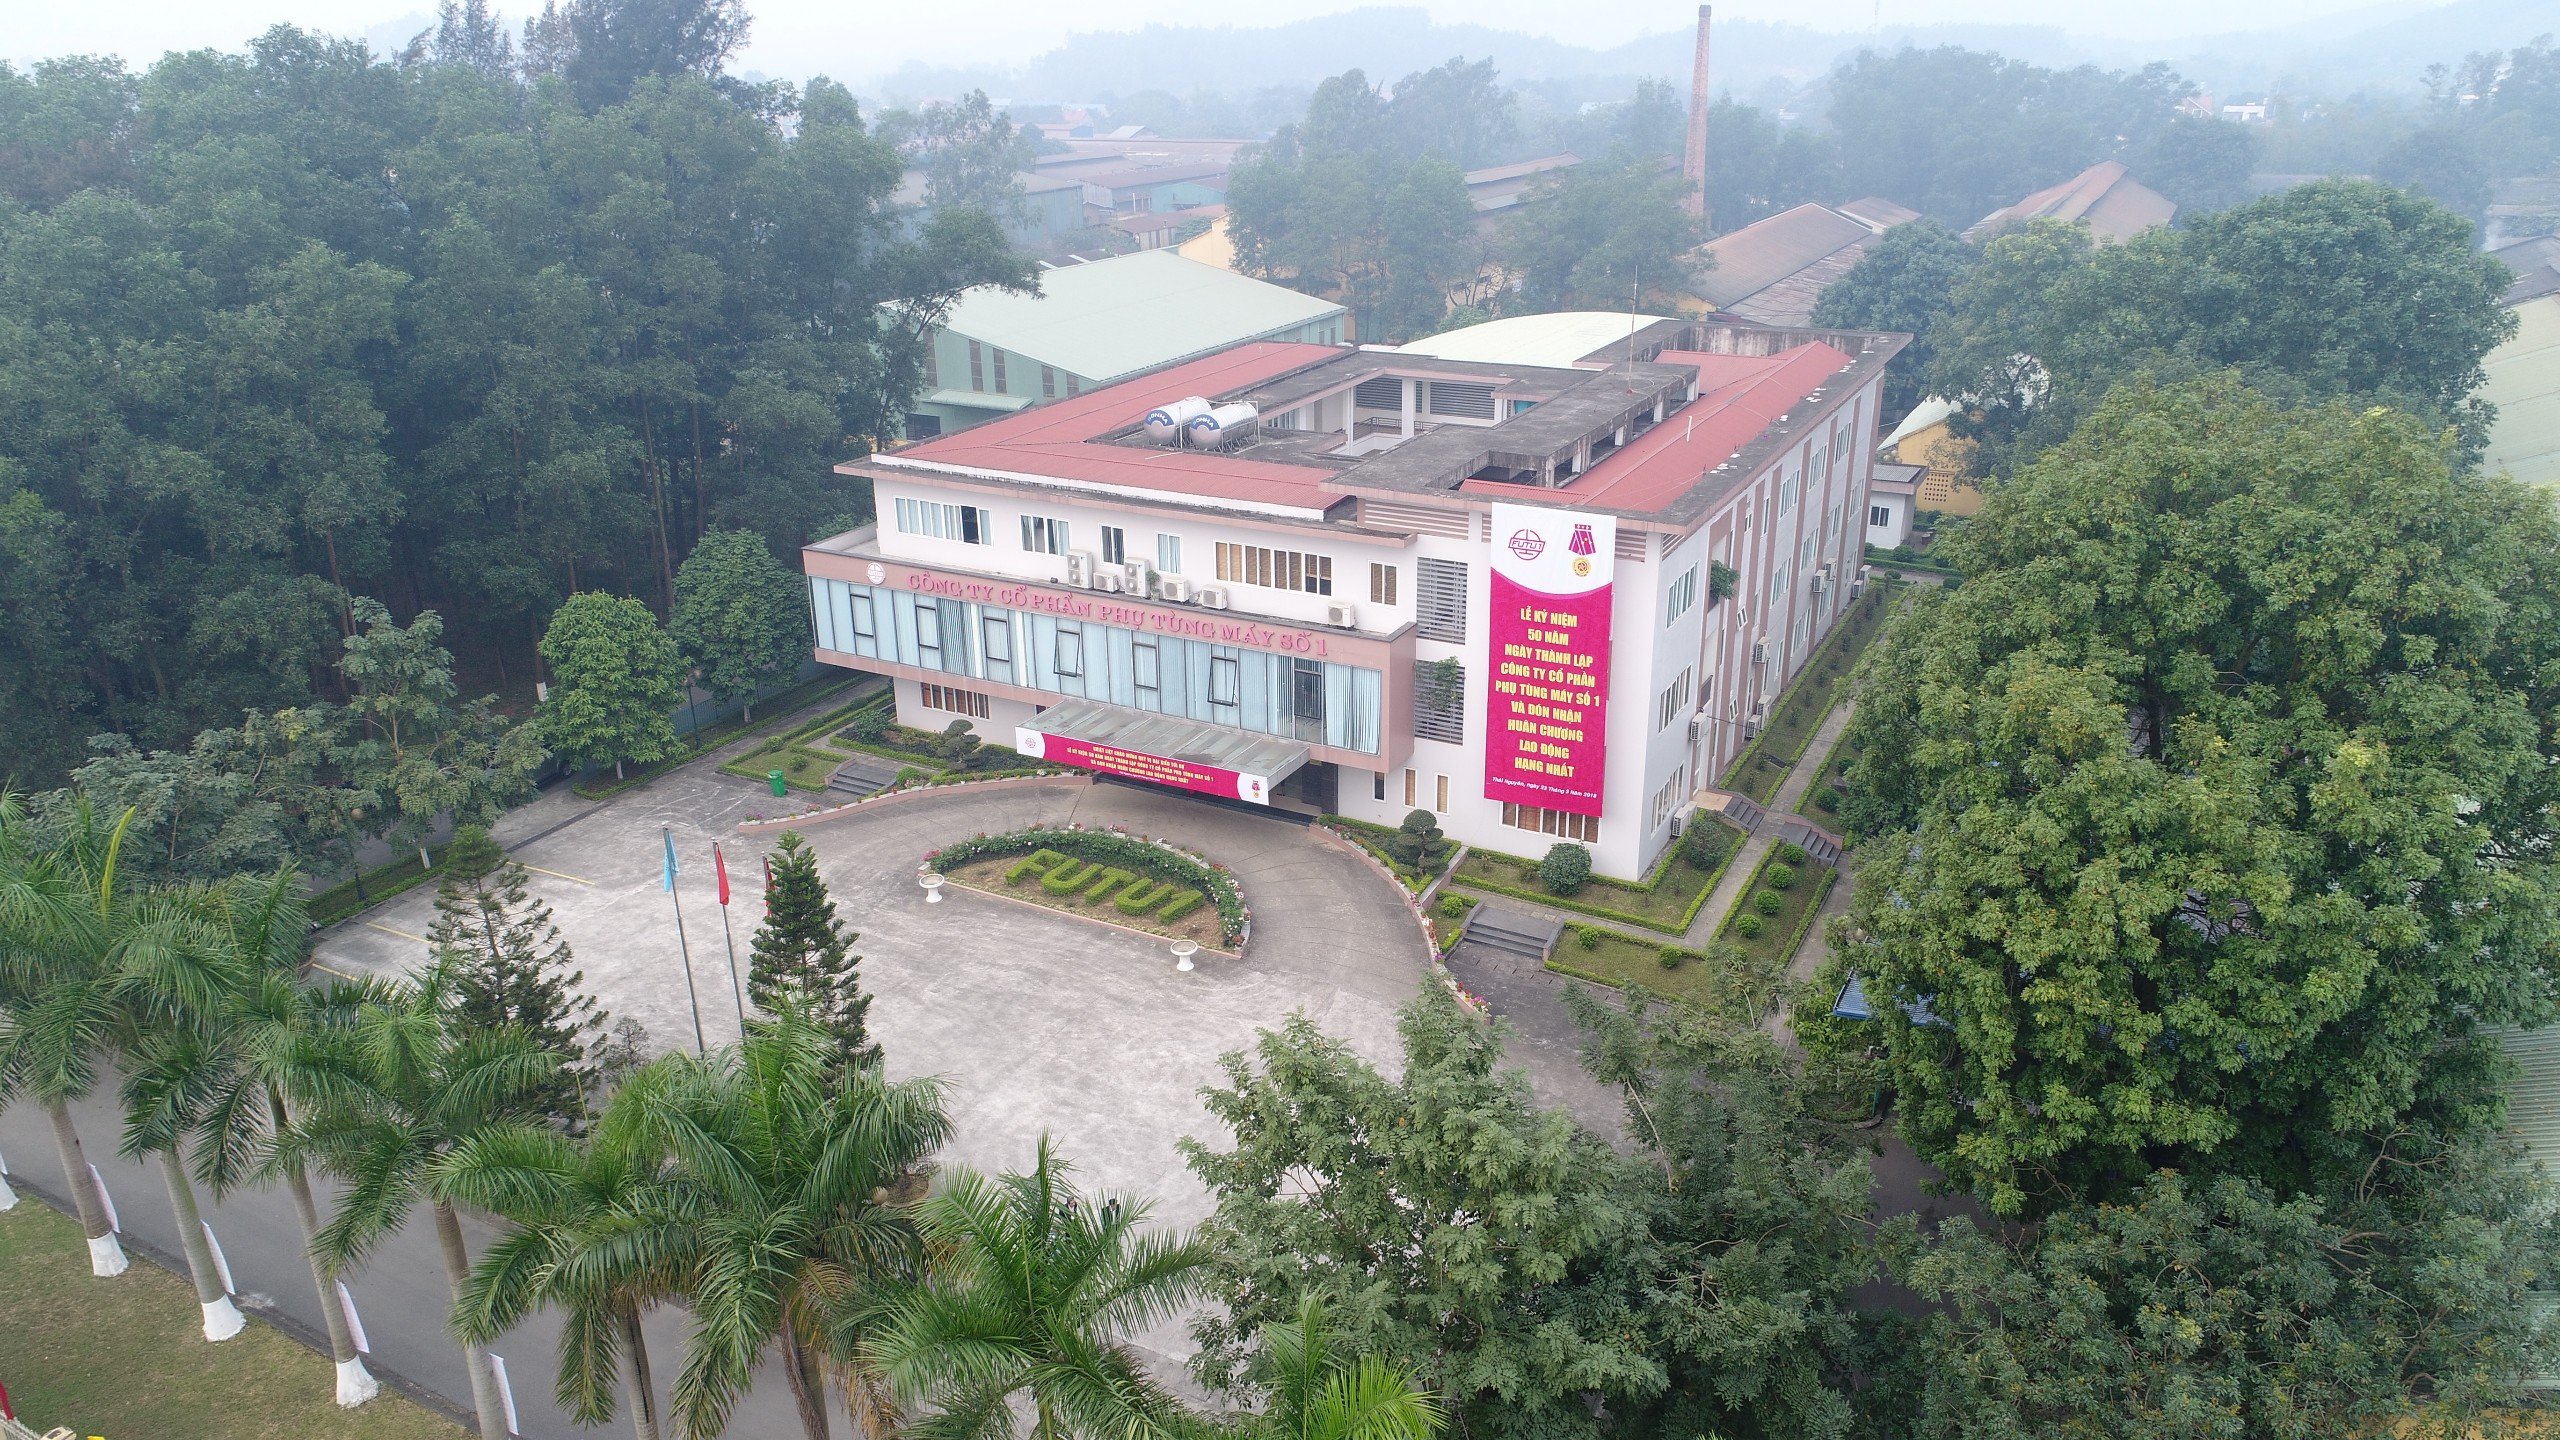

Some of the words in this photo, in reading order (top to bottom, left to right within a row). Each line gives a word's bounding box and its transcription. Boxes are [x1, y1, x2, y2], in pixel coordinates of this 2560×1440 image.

[908, 571, 962, 597] CÔNG
[966, 583, 994, 602] TY
[1001, 584, 1027, 606] CỔ
[1032, 592, 1092, 617] PHẦN
[1097, 603, 1146, 630] PHỤ
[1150, 610, 1216, 639] TÙNG
[1220, 623, 1275, 648] MÁY
[1279, 631, 1312, 653] SỐ
[1316, 638, 1328, 656] 1
[1521, 605, 1532, 621] LỄ
[1550, 612, 1578, 628] NIỆM
[1528, 628, 1542, 642] 50
[1544, 630, 1569, 646] NĂM
[1504, 643, 1533, 659] NGÀY
[1535, 649, 1571, 665] THÀNH
[1573, 653, 1593, 669] LẬP
[1500, 662, 1530, 677] CÔNG
[1533, 667, 1546, 680] TY
[1566, 671, 1595, 688] PHẦN
[1495, 680, 1517, 694] PHỤ
[1519, 683, 1548, 700] TÙNG
[1550, 689, 1573, 704] MÁY
[1576, 691, 1591, 706] SỐ
[1594, 695, 1600, 707] 1
[1511, 701, 1525, 714] VÀ
[1528, 703, 1550, 718] ĐÓN
[1552, 709, 1582, 724] NHẬN
[1507, 719, 1537, 735] HUÂN
[1540, 724, 1584, 742] CHƯƠNG
[1519, 739, 1537, 753] LAO
[1540, 742, 1570, 759] ĐỘNG
[1514, 757, 1543, 772] HẠNG
[1546, 762, 1575, 778] NHẤT
